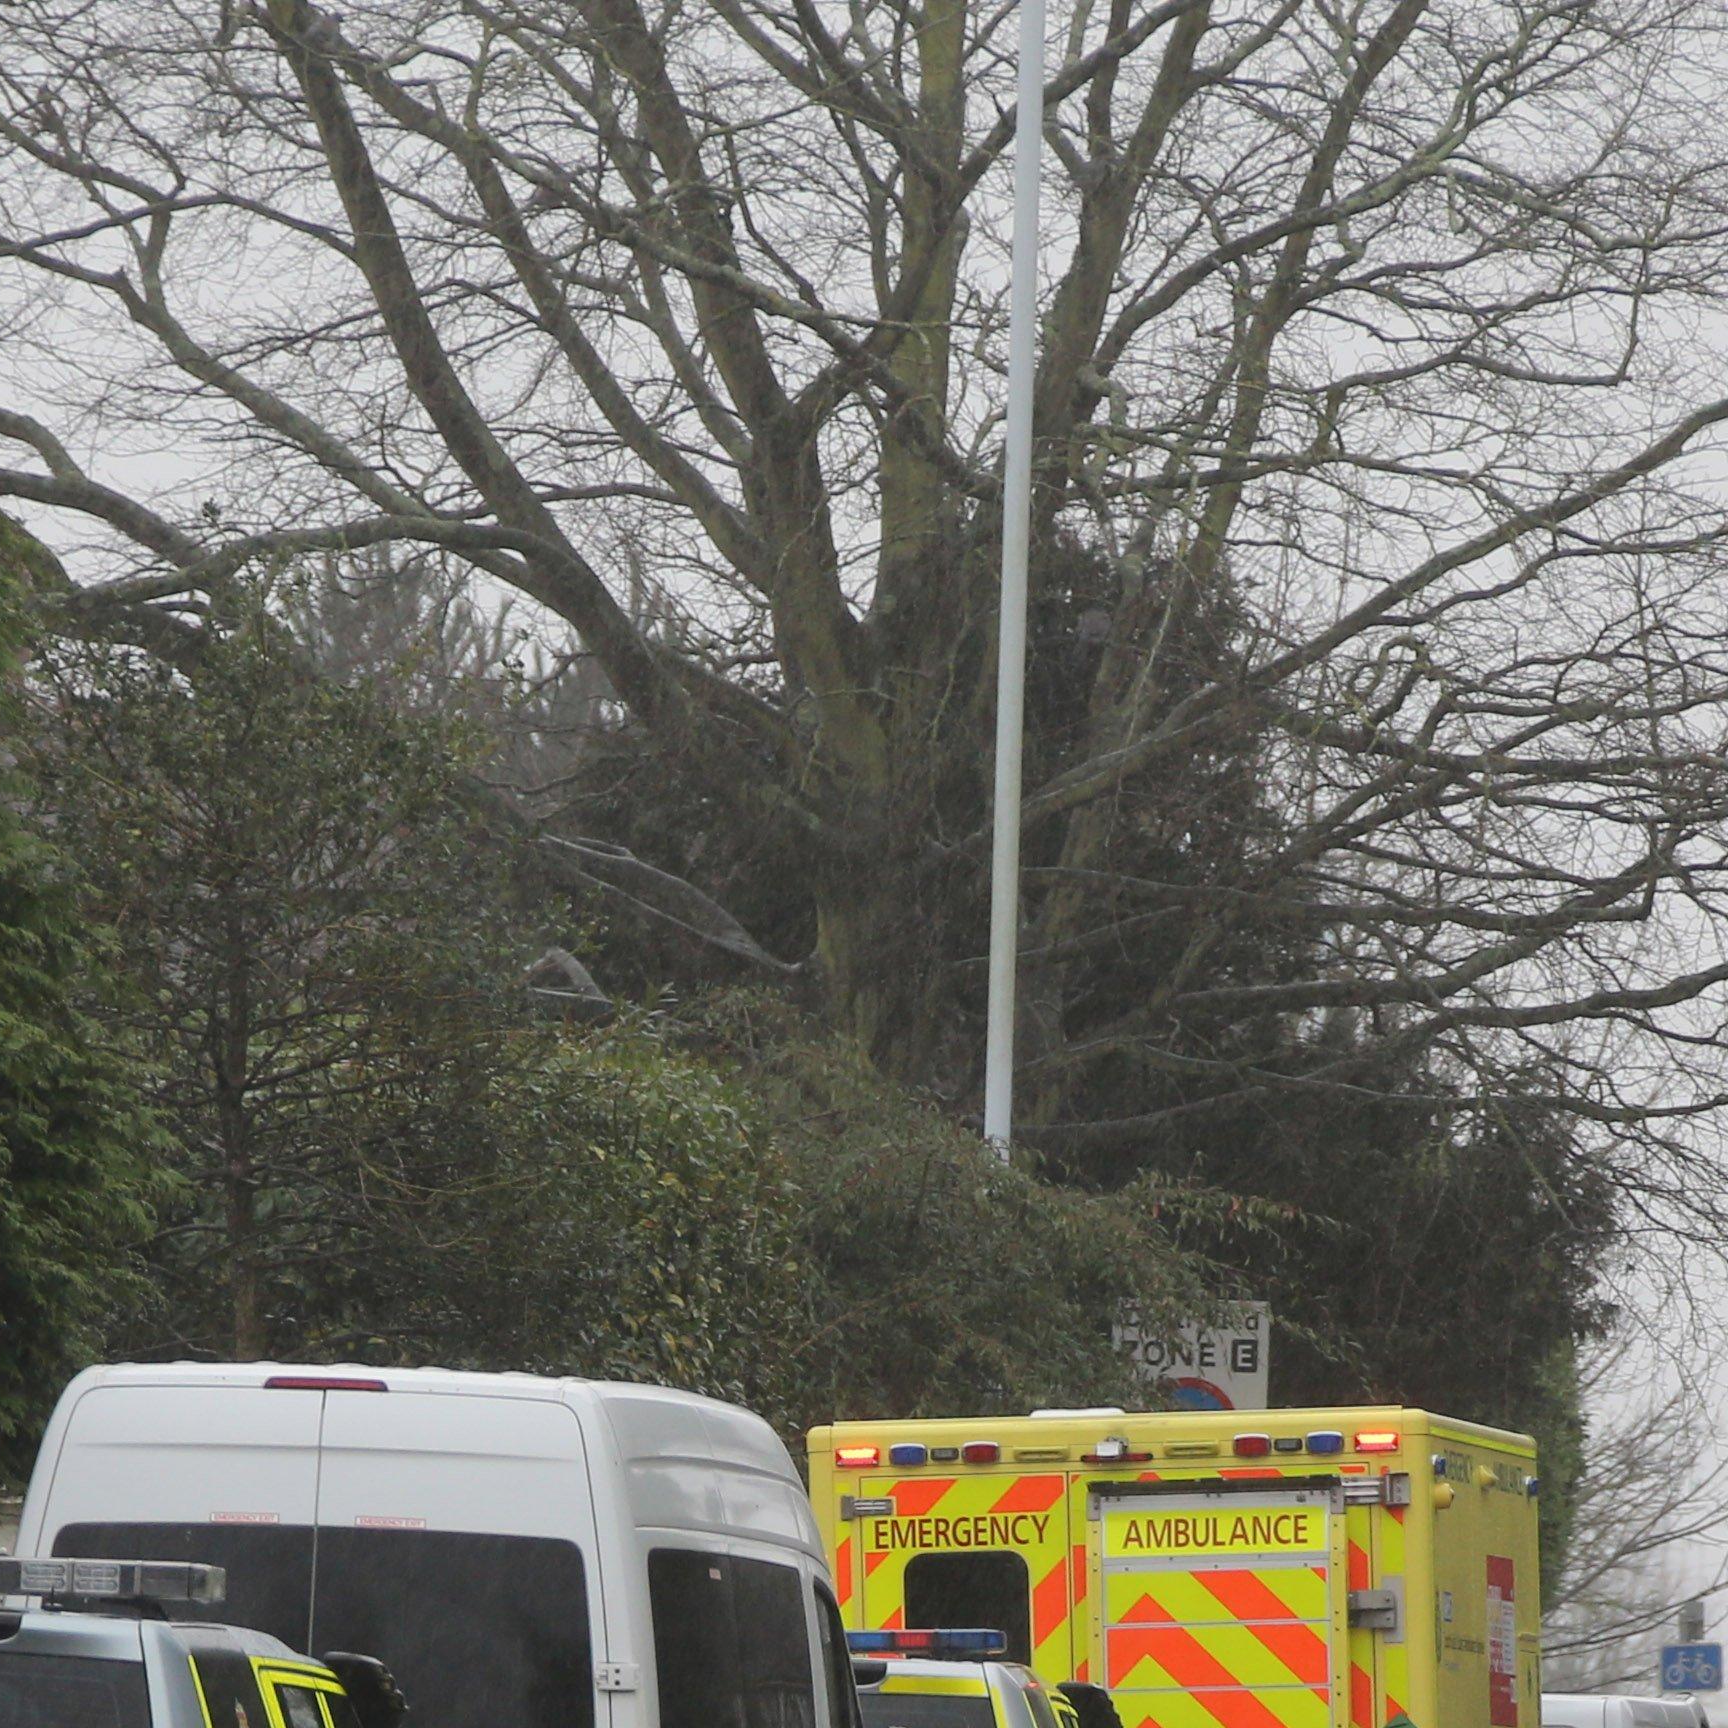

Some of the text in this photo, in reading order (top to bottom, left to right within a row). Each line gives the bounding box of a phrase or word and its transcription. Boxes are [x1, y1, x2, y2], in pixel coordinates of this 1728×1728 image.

[1237, 1345, 1253, 1367] E
[874, 1514, 1050, 1549] EMERGENCY
[1121, 1513, 1309, 1549] AMBULANCE
